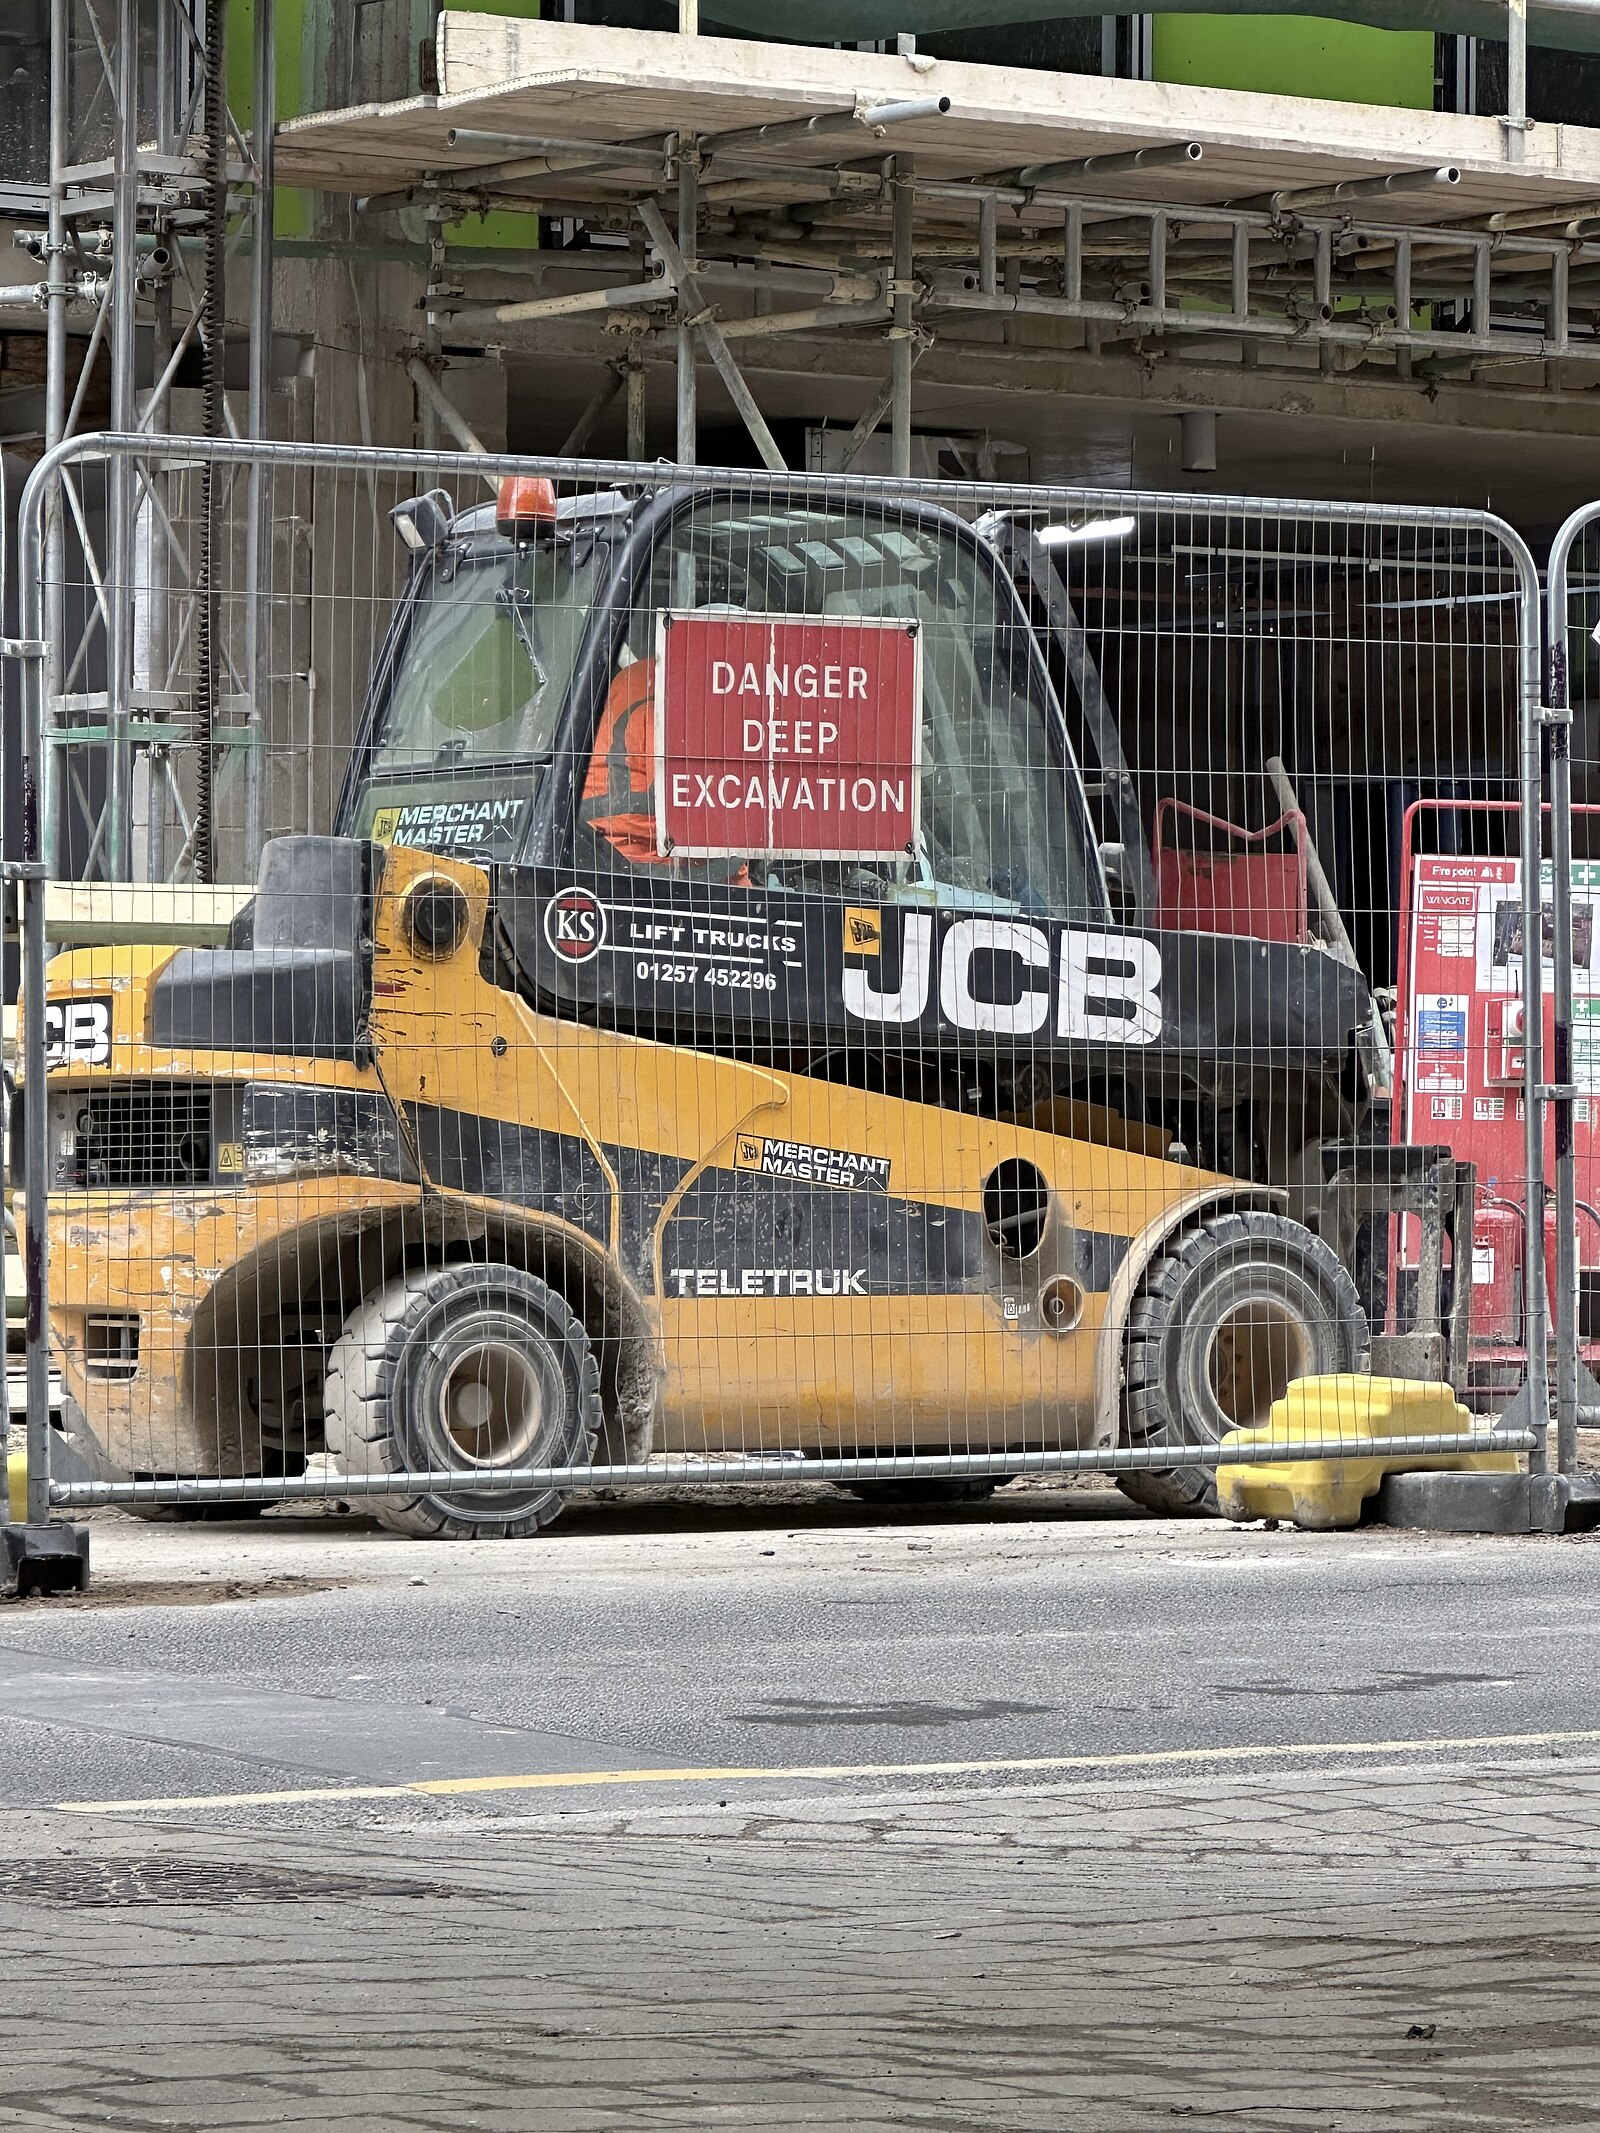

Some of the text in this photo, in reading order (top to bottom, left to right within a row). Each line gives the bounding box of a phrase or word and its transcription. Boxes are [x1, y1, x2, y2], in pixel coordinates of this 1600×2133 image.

[712, 661, 868, 699] DANGER
[743, 719, 838, 754] DEEP
[672, 774, 904, 812] EXCAVATION
[399, 800, 524, 825] MERCHANT
[393, 823, 484, 845] MASTER
[1432, 865, 1476, 878] Fire point
[557, 909, 595, 941] KS
[630, 923, 796, 952] LIFT TRUCKS
[636, 961, 777, 991] 01257 452296
[842, 913, 1162, 1044] JCB
[764, 1139, 889, 1174] MERCHANT
[762, 1157, 855, 1187] MASTER
[670, 1268, 868, 1295] TELETRUK
